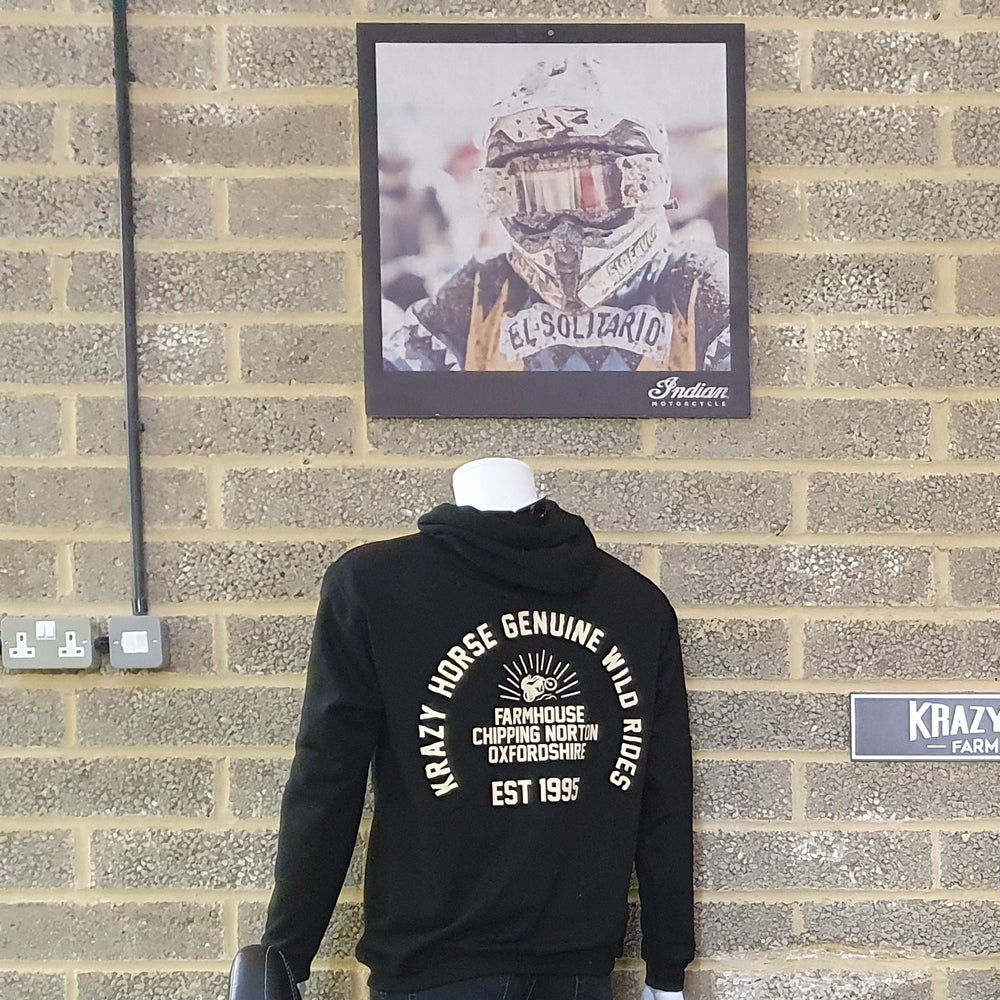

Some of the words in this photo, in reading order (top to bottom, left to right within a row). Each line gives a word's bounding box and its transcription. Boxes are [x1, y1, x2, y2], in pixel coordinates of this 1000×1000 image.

[508, 319, 536, 350] EL
[541, 311, 661, 347] SOLITARIO
[648, 376, 729, 399] Indian
[501, 610, 605, 653] GENUINE
[427, 622, 498, 699] HORSE
[601, 645, 639, 709] WILD
[494, 706, 585, 726] FARMHOUSE
[418, 704, 459, 797] KRAZY
[472, 726, 541, 746] CHIPPING
[545, 724, 599, 743] NORTON
[952, 739, 999, 754] FARM
[488, 743, 587, 764] OXFORDSHIRE
[609, 718, 643, 791] RIDES
[491, 779, 532, 806] EST
[538, 777, 581, 802] 1995
